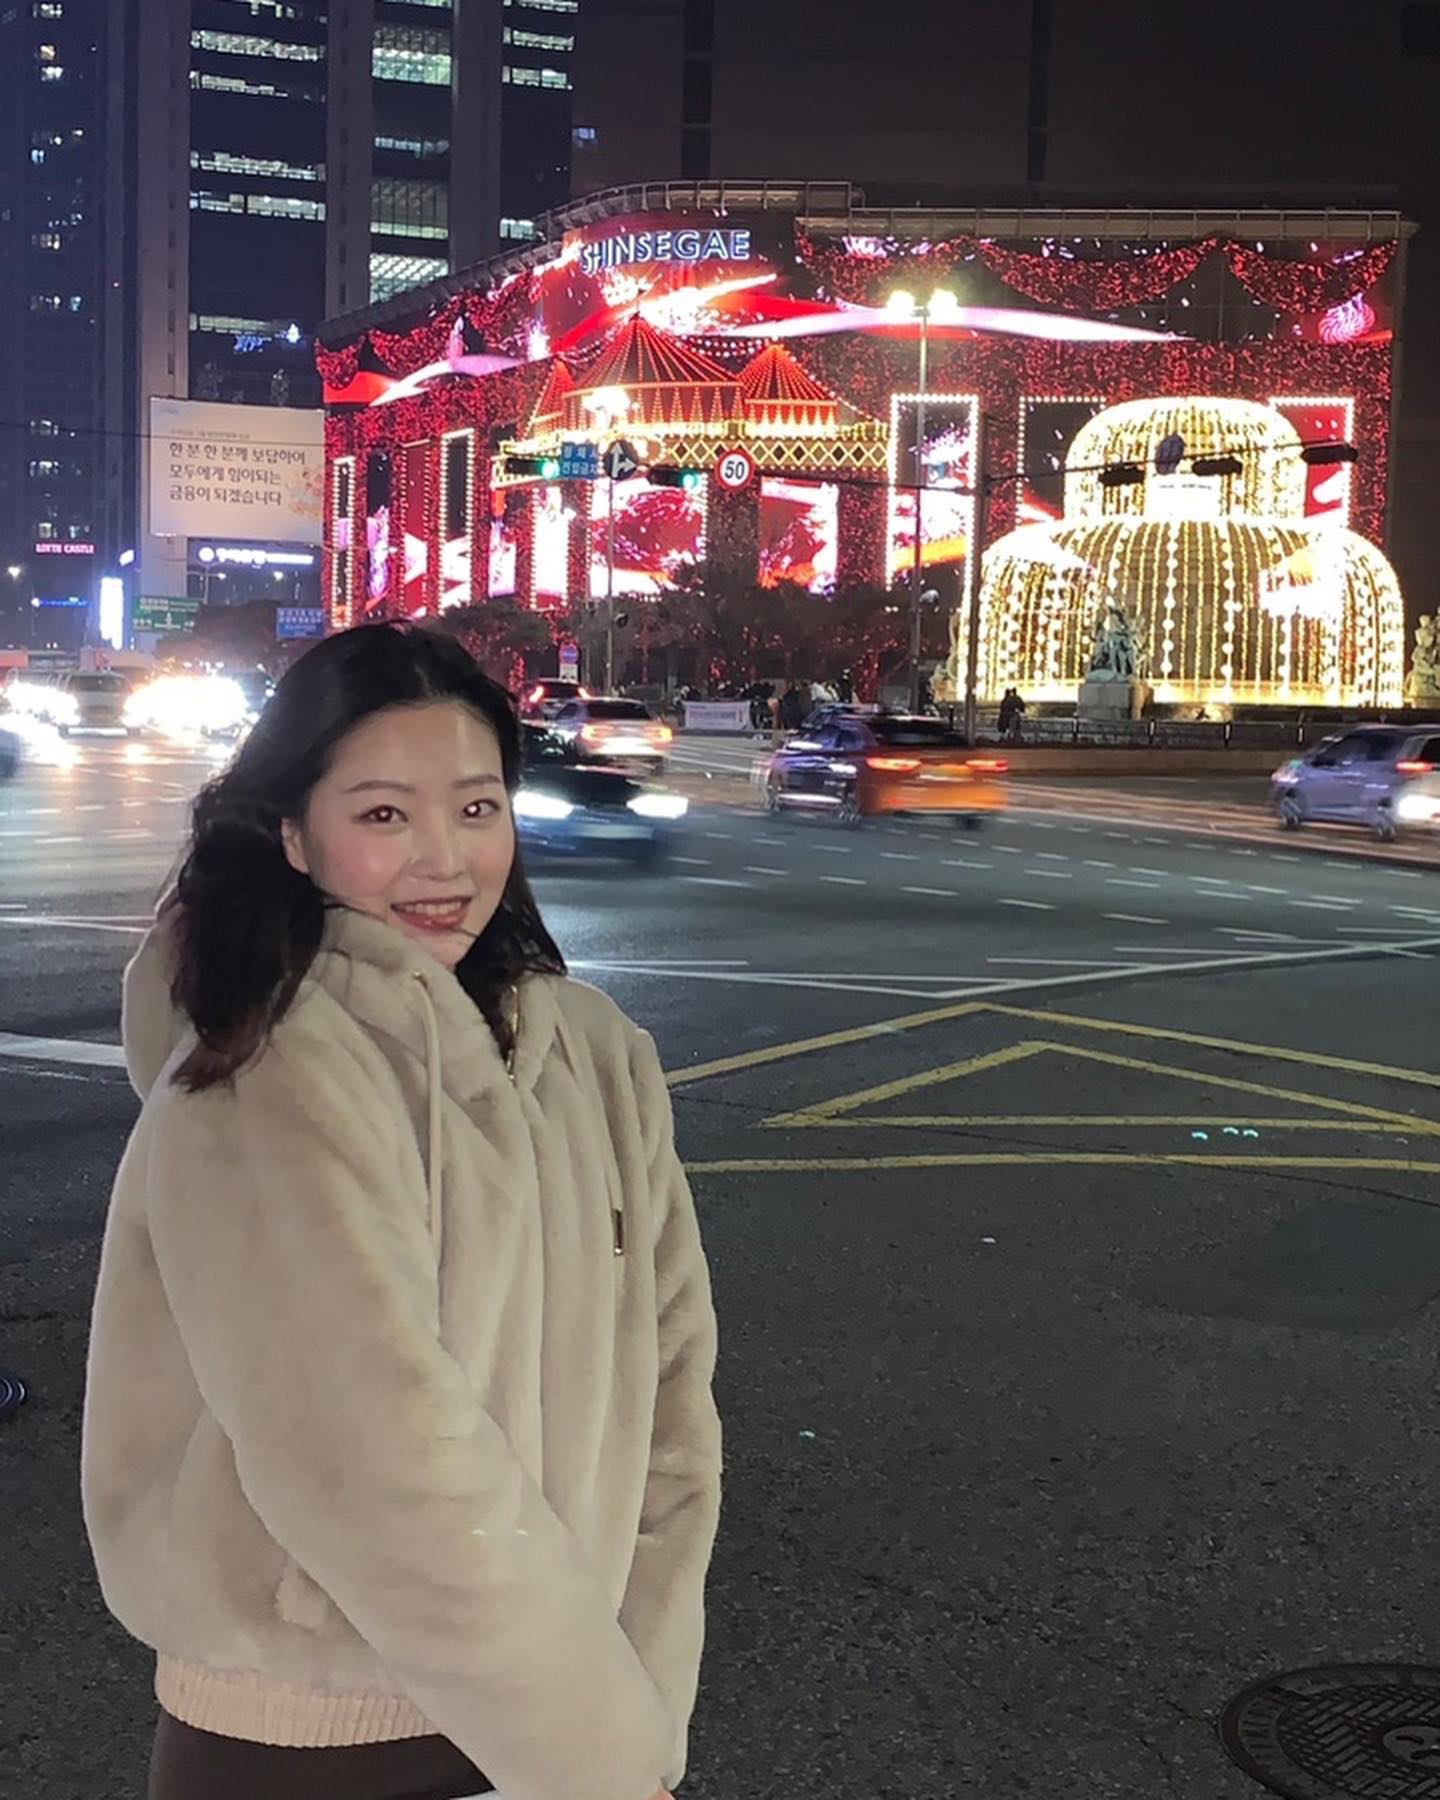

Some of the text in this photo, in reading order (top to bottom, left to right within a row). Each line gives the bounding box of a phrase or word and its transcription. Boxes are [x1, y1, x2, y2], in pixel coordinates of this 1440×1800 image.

[581, 229, 750, 275] SHINSEGAE
[169, 442, 183, 458] 한
[187, 443, 200, 459] 분
[203, 444, 217, 460] 한
[169, 463, 225, 481] 모두에게
[724, 460, 745, 480] 50
[169, 484, 282, 506] 금융이 되겠습니다
[63, 543, 95, 555] CASTLE
